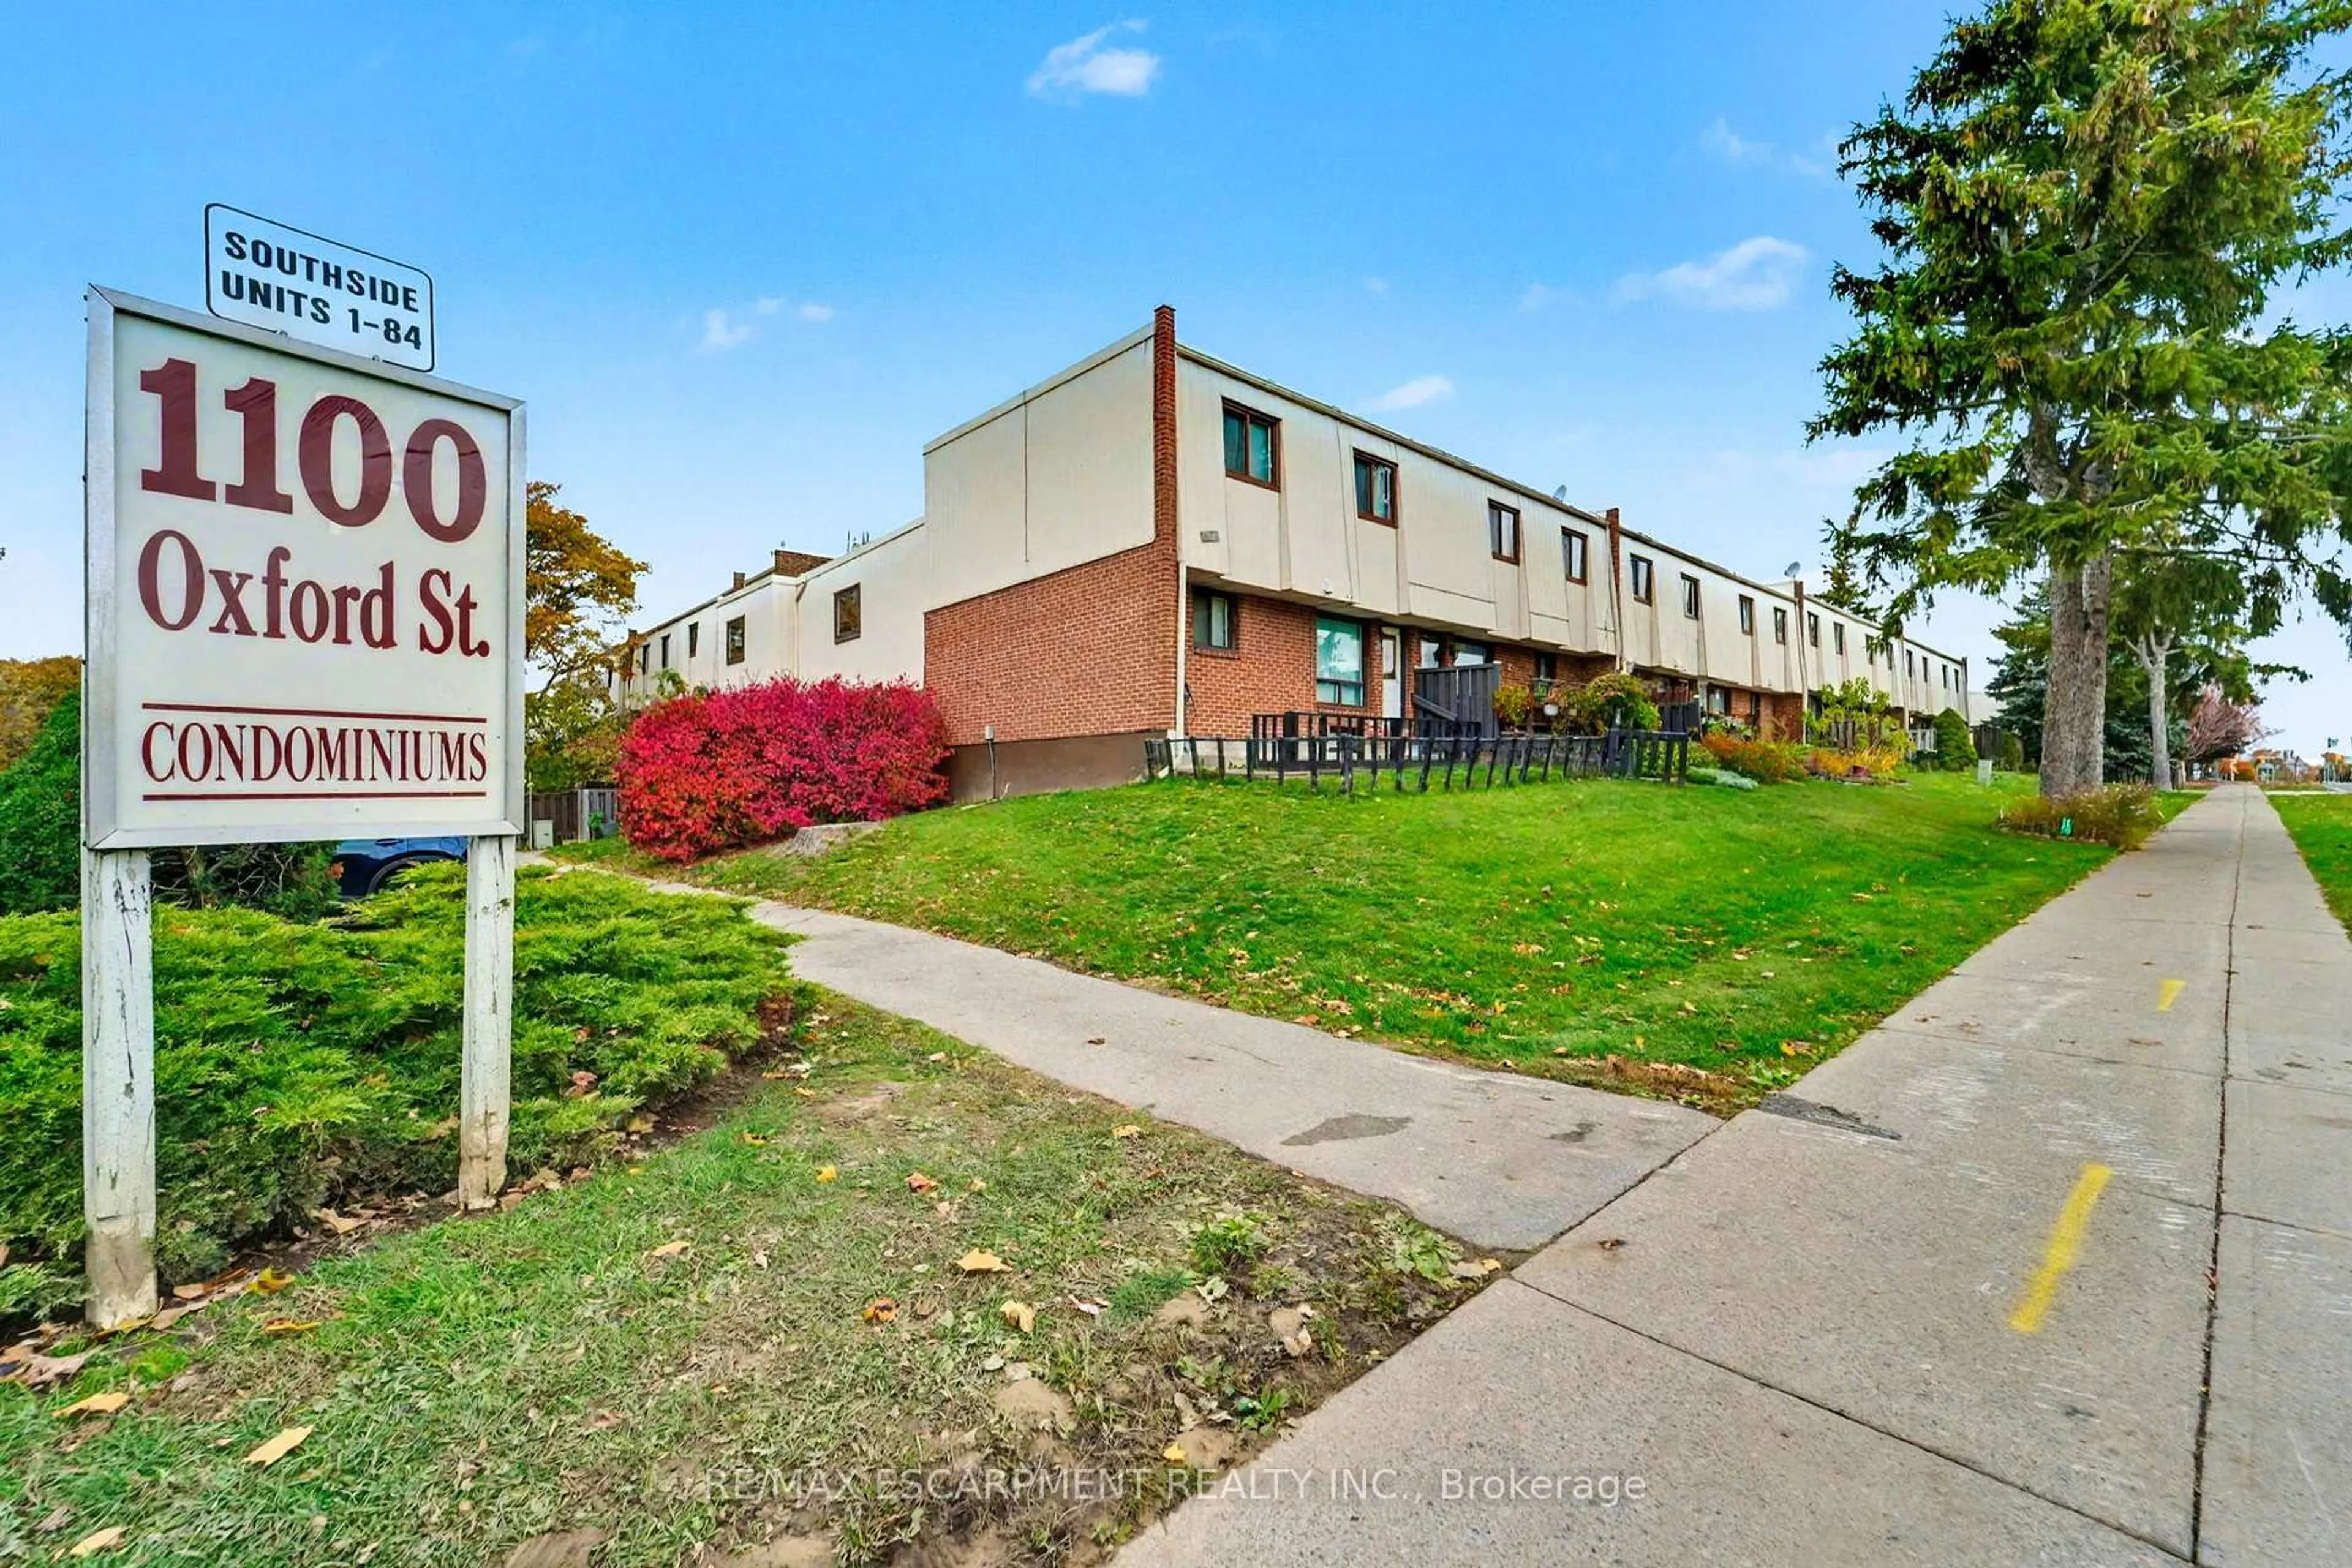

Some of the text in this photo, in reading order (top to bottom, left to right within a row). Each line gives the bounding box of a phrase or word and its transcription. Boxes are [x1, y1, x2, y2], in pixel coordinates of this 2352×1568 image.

[222, 270, 421, 350] UNITS 1-84
[225, 231, 419, 313] SOUTHSIDE
[140, 357, 486, 543] 1100
[138, 529, 489, 657] Oxford St.
[141, 721, 486, 783] CONDOMINIUMS
